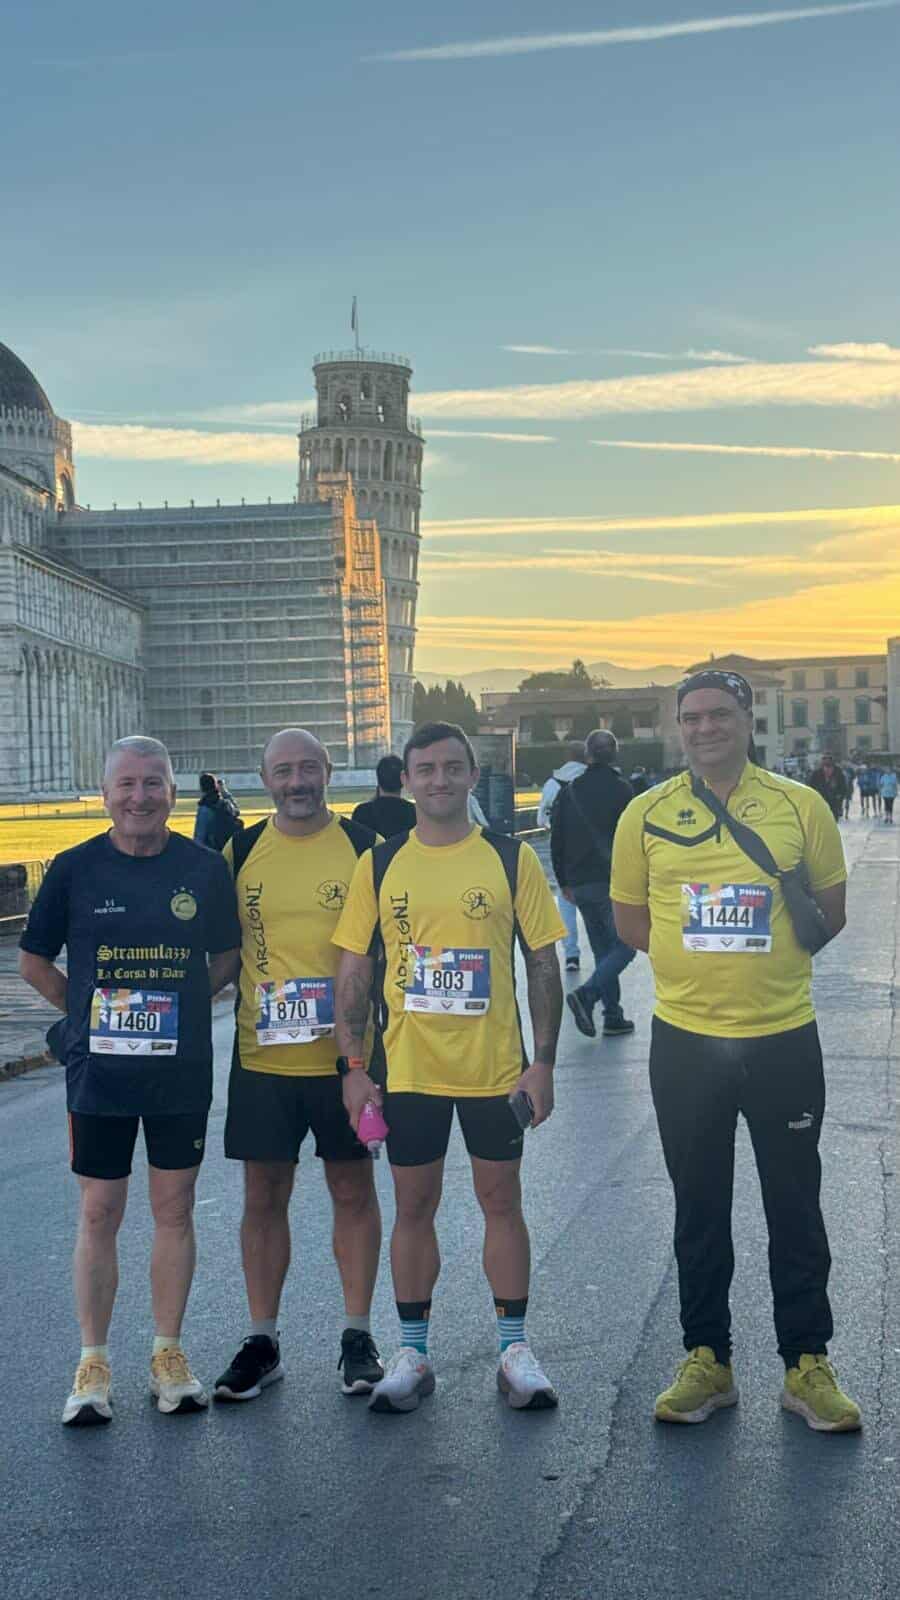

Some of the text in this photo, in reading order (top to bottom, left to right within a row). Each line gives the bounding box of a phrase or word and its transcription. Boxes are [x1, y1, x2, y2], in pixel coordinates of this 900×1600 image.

[707, 906, 750, 926] 1444
[113, 967, 146, 980] Corsa
[149, 967, 159, 979] di
[432, 970, 464, 990] 803
[277, 999, 308, 1020] 870
[117, 1011, 157, 1032] 1460
